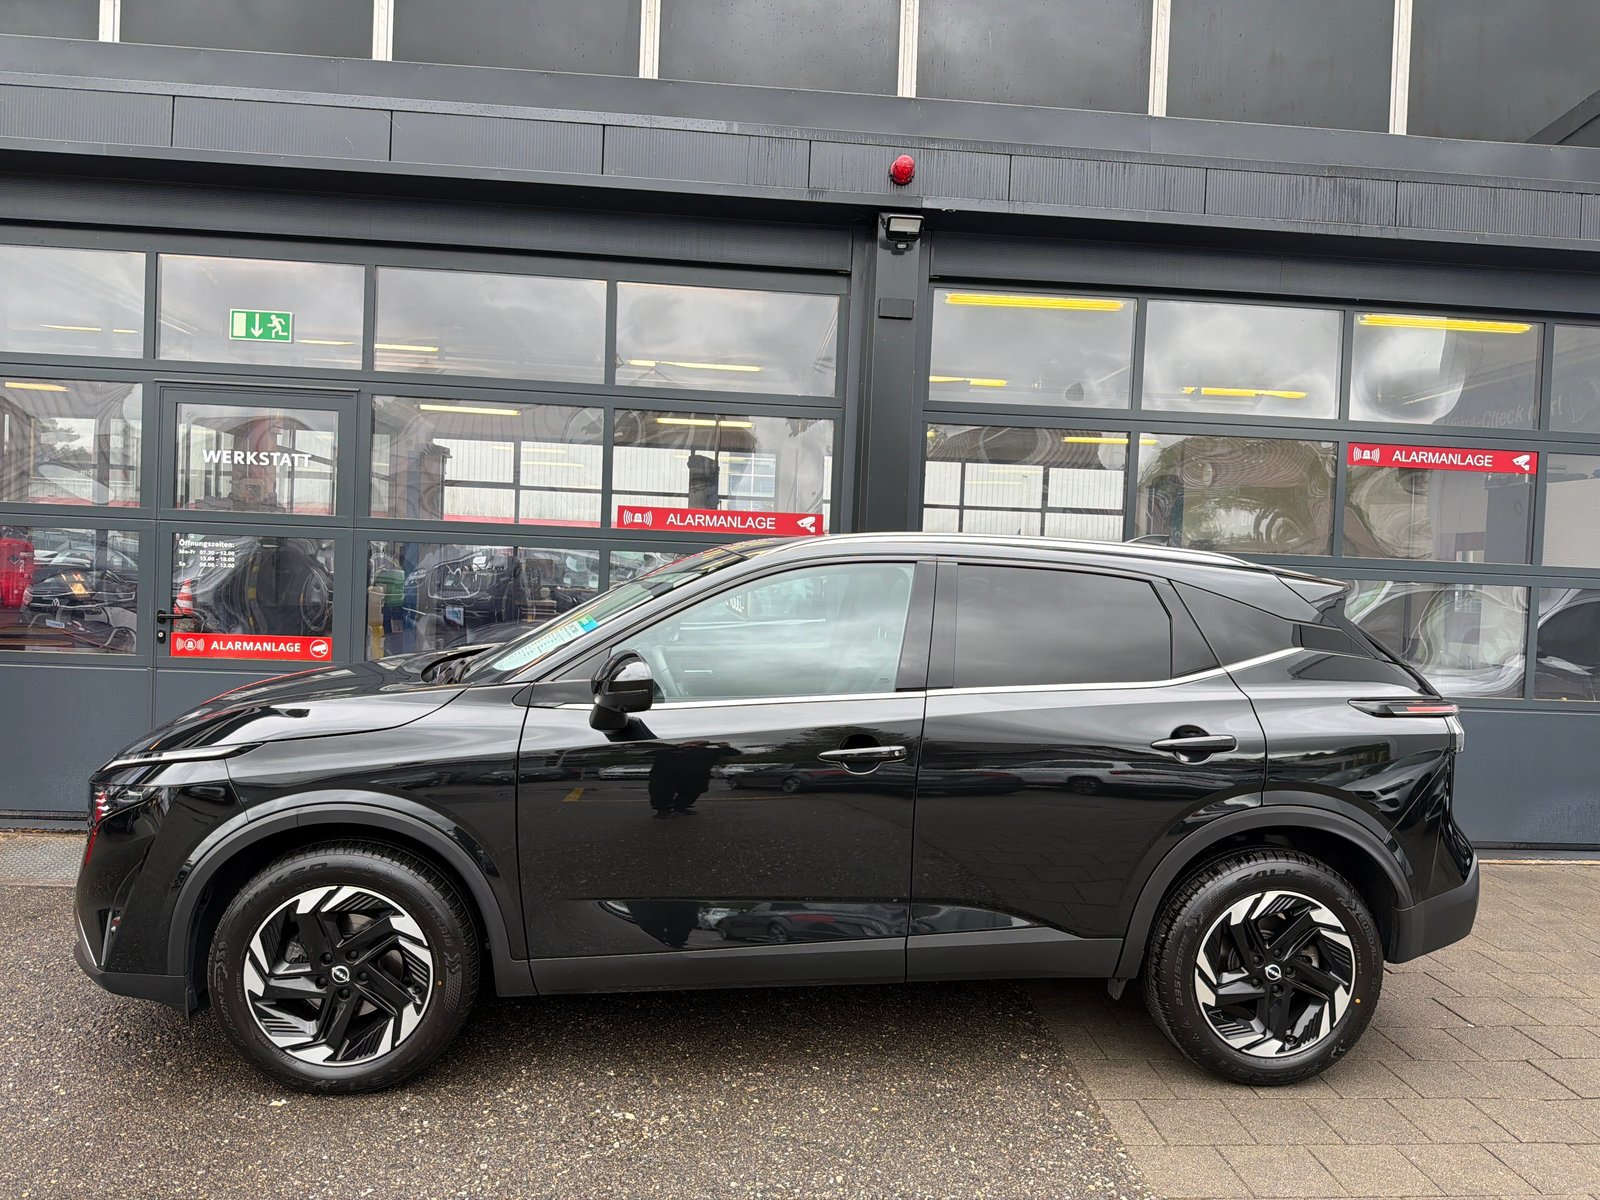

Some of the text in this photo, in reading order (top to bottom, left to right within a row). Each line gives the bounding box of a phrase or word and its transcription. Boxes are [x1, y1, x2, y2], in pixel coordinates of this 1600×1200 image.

[203, 450, 311, 467] WERKSTATT
[1391, 449, 1493, 468] ALARMANLAGE
[666, 513, 776, 530] ALARMANLAGE
[179, 539, 235, 548] Öffnungszeiten:
[210, 640, 301, 653] ALARMANLAGE
